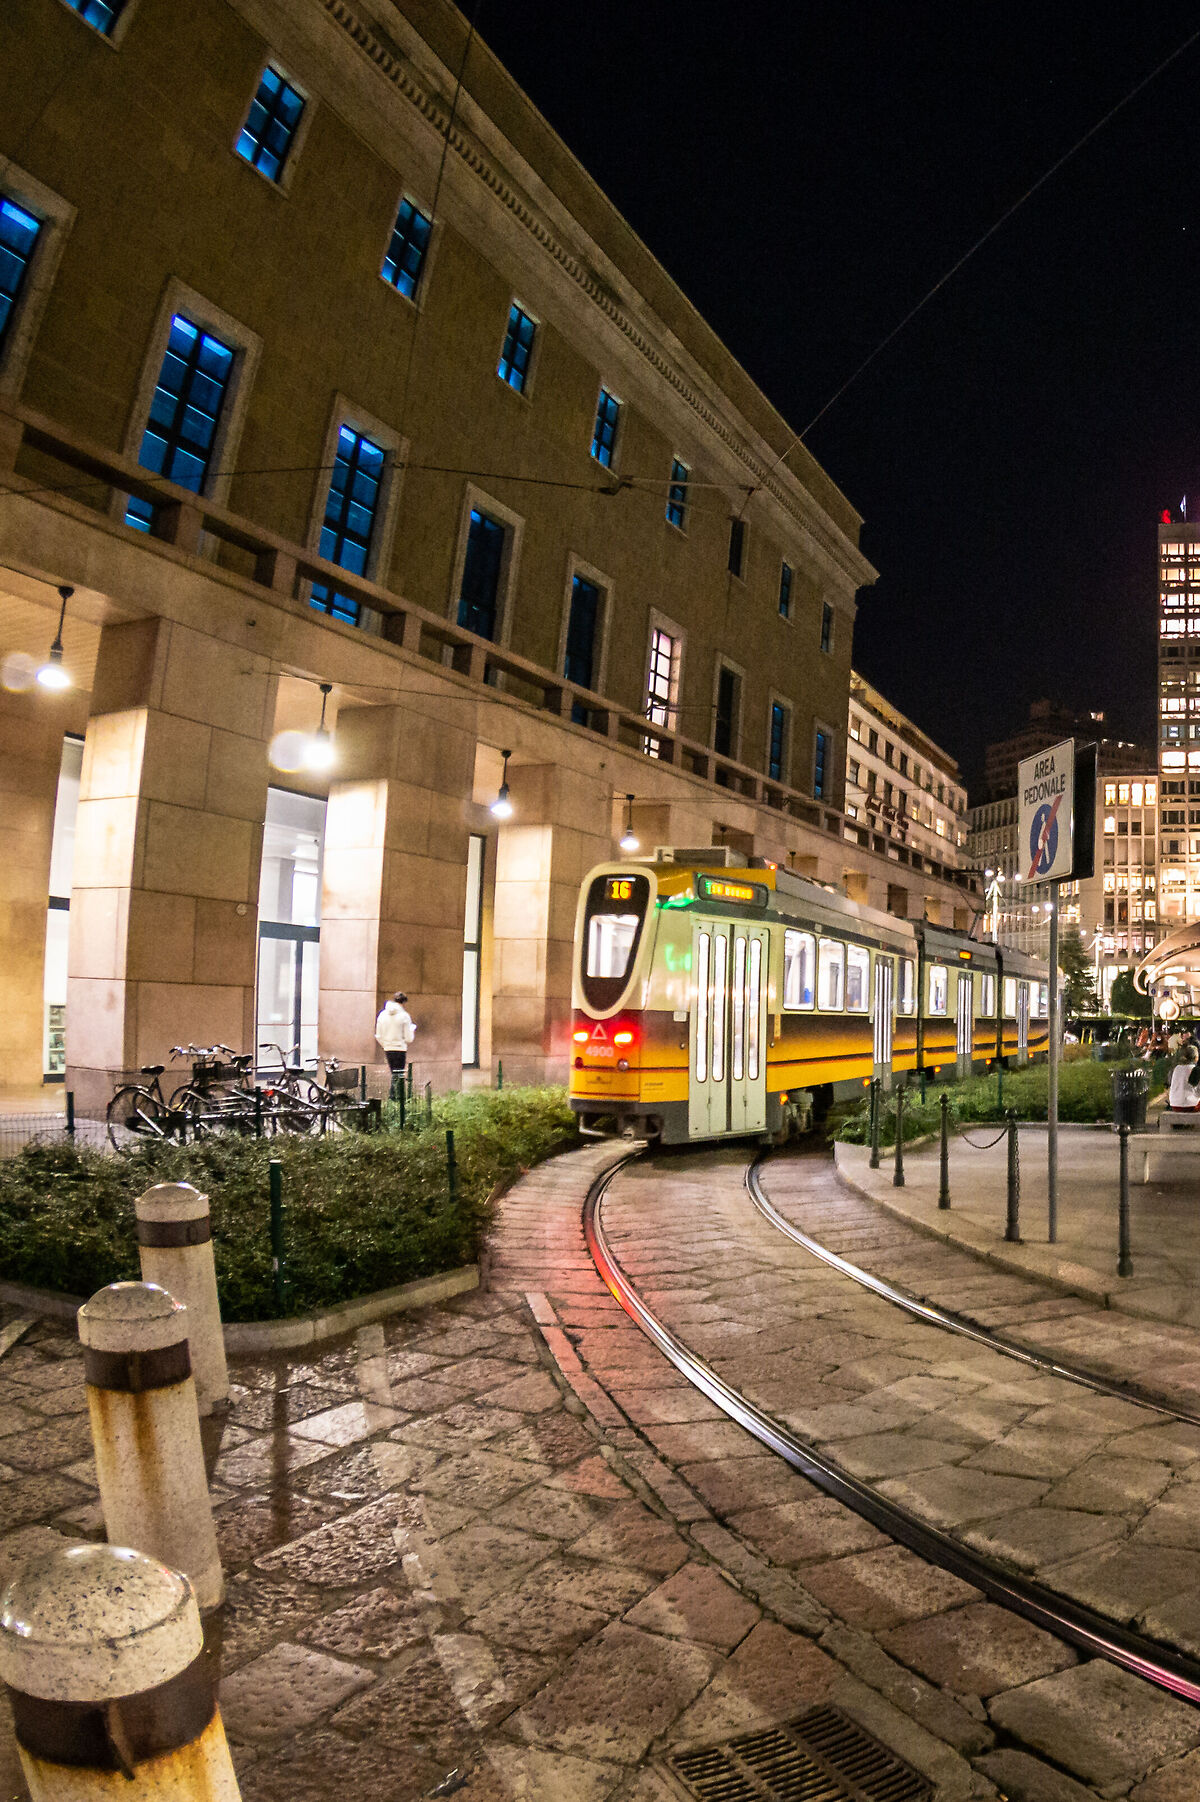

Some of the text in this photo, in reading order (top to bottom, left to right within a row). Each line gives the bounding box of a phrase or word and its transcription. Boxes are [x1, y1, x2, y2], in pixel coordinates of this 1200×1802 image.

[1034, 755, 1055, 781] AREA
[1024, 773, 1066, 806] PEDONALE
[611, 881, 632, 899] 16
